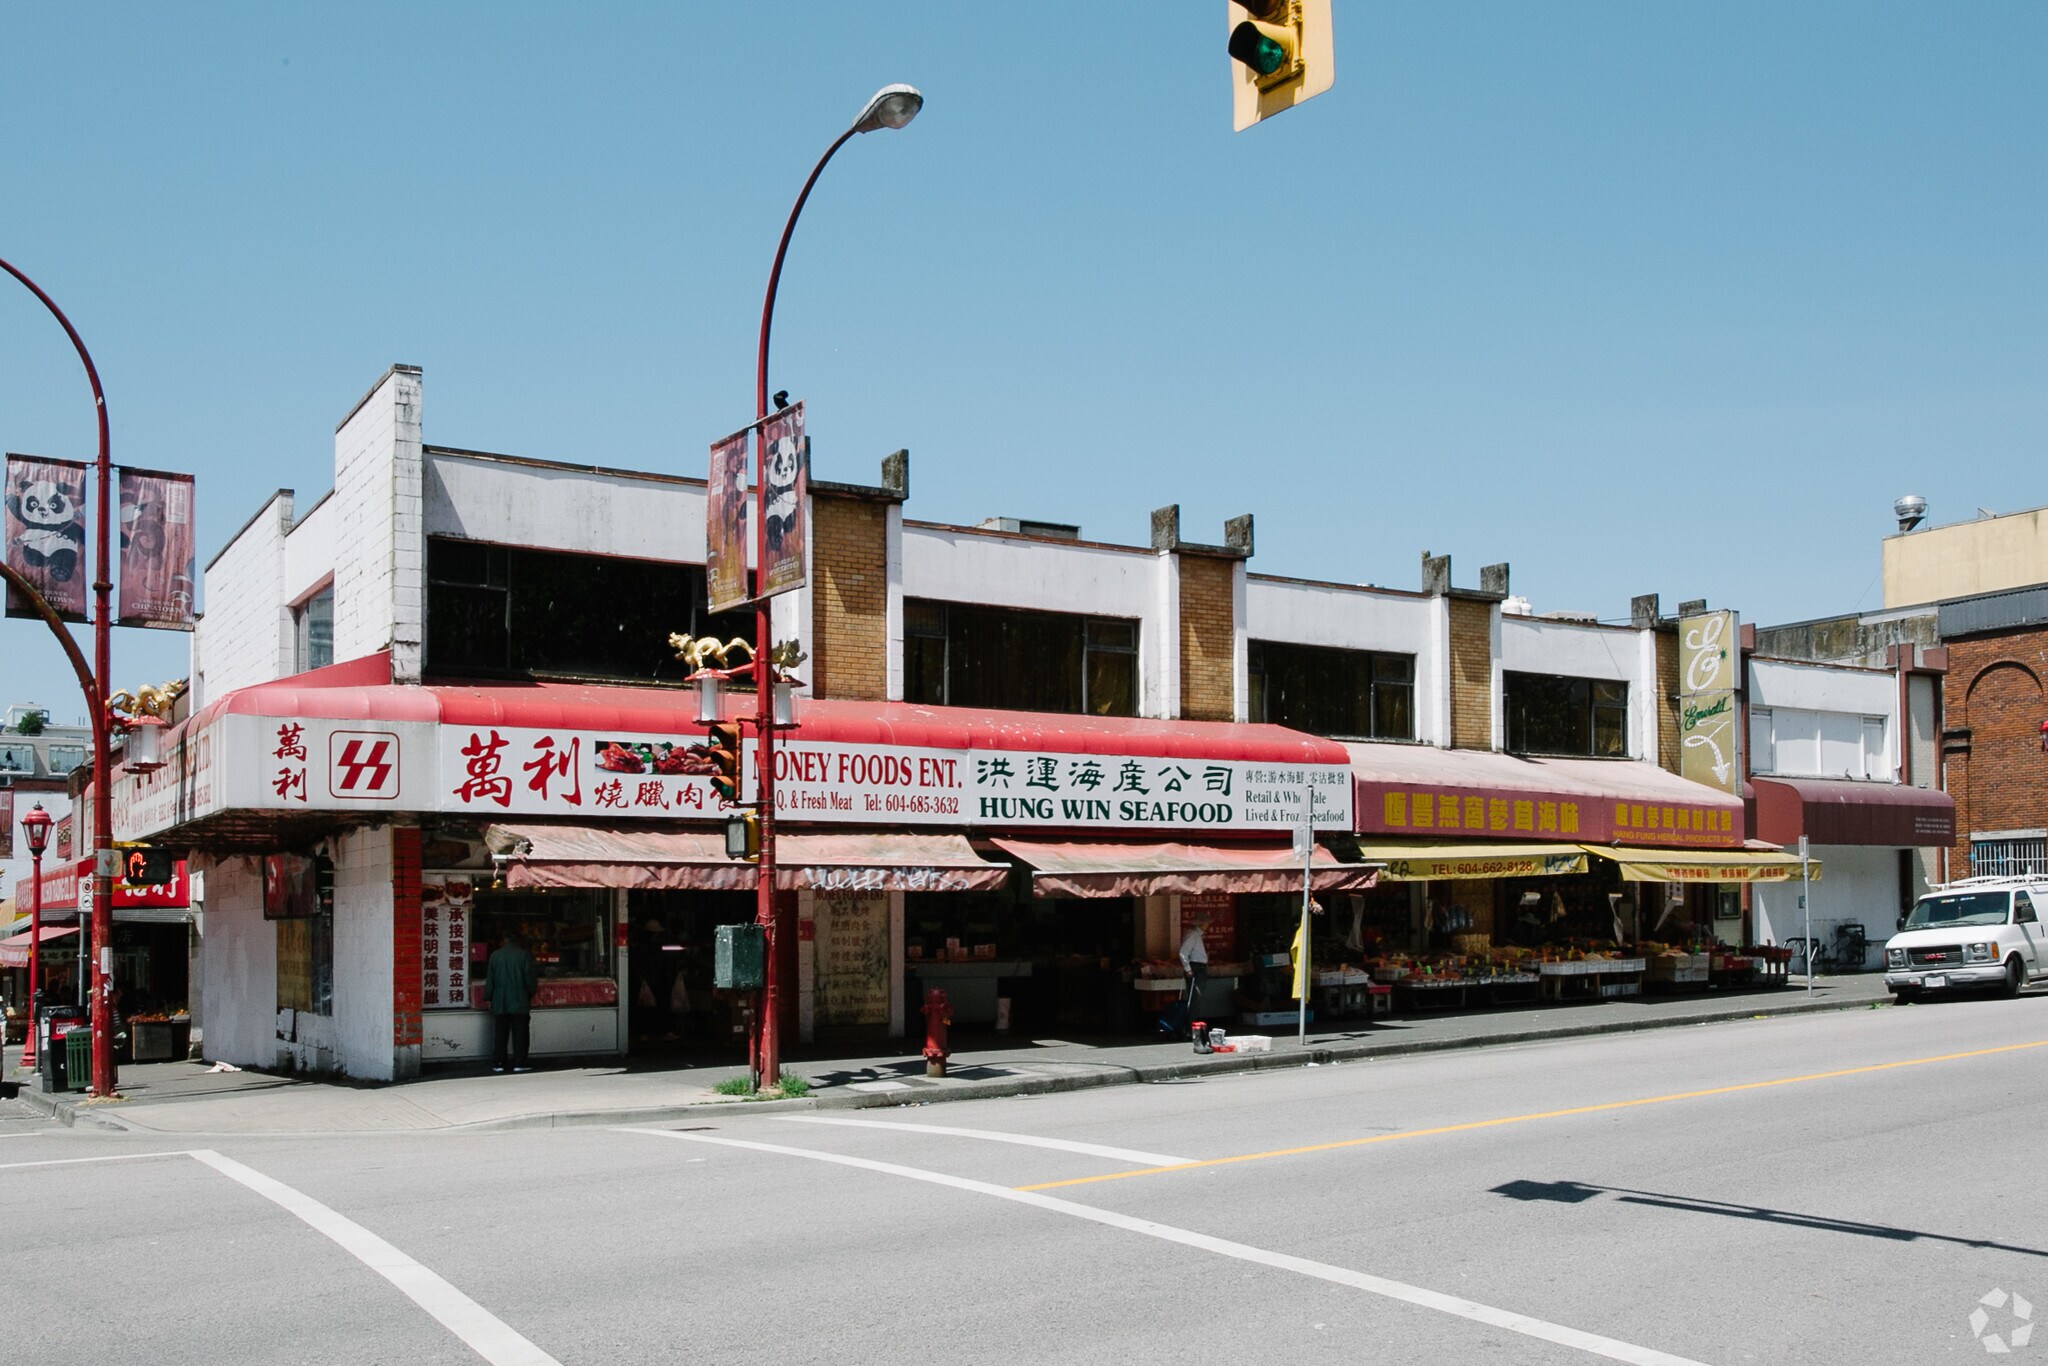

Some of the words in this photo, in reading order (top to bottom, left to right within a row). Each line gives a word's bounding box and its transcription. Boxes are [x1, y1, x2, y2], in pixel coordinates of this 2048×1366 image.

[272, 722, 308, 803] 萬利
[452, 729, 581, 808] 萬利
[838, 754, 912, 787] FOODS
[919, 757, 963, 789] ENT.
[790, 790, 799, 810] &
[801, 790, 827, 811] Fresh
[830, 792, 853, 811] Meat
[864, 794, 882, 812] Tel:
[885, 795, 959, 814] 604-685-3632
[1245, 790, 1272, 804] Retail
[1273, 790, 1281, 804] &
[979, 797, 1054, 819] HUNG
[1061, 799, 1111, 821] WIN
[1118, 800, 1233, 823] SEAFOOD
[1245, 808, 1269, 822] Lived
[1270, 808, 1278, 822] &
[1613, 830, 1634, 840] HANG
[1635, 832, 1656, 841] FUNG
[1657, 833, 1684, 842] HERBAL
[1685, 834, 1721, 843] PRODUCTS
